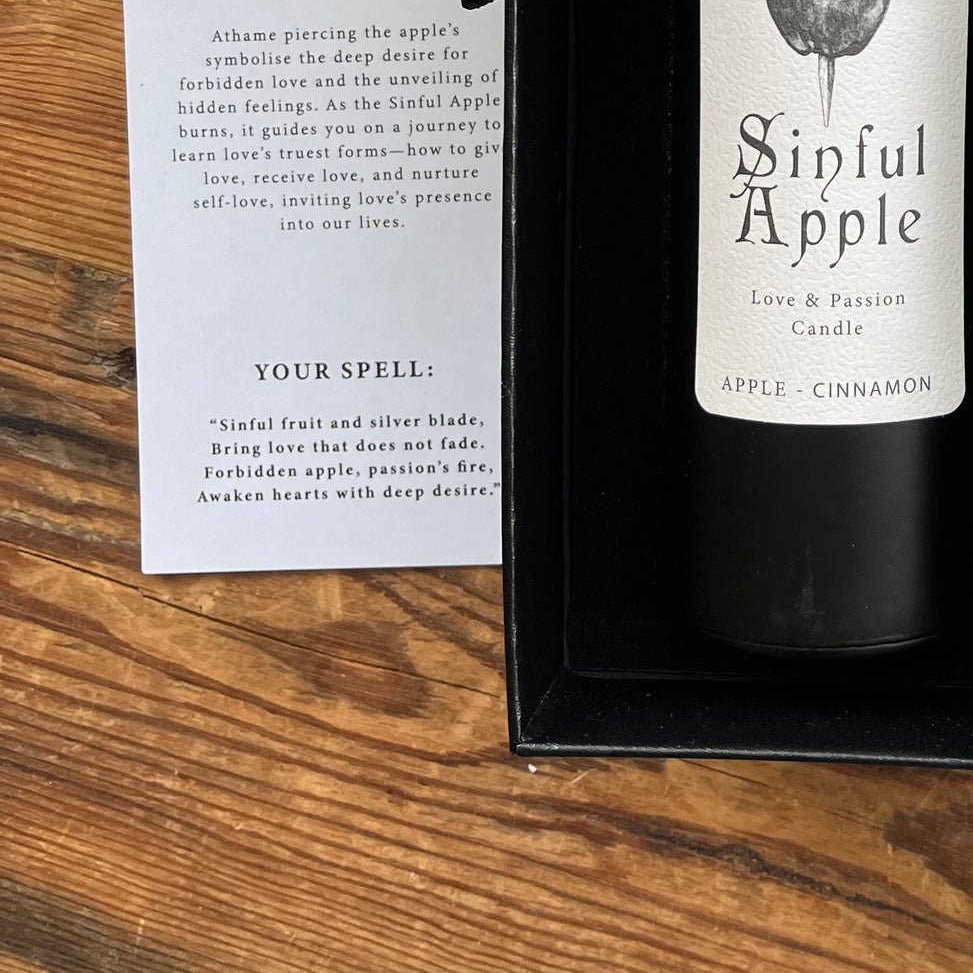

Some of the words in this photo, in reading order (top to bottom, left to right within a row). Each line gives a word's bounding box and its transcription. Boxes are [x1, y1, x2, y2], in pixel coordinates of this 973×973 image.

[211, 28, 277, 43] Athame
[284, 26, 357, 46] piercing
[364, 24, 392, 39] the
[399, 22, 460, 42] apple’s
[205, 51, 292, 71] symbolise
[298, 50, 326, 65] the
[333, 49, 374, 67] deep
[382, 47, 435, 62] desire
[443, 45, 469, 61] for
[179, 75, 264, 91] forbidden
[271, 74, 308, 89] love
[315, 73, 346, 88] and
[353, 72, 381, 87] the
[388, 70, 473, 88] unveiling
[480, 68, 499, 84] of
[177, 99, 237, 115] hidden
[245, 98, 319, 117] feelings.
[325, 98, 347, 112] As
[354, 96, 381, 111] the
[389, 94, 442, 110] Sinful
[448, 92, 501, 112] Apple
[178, 124, 234, 139] burns,
[241, 123, 254, 137] it
[262, 121, 318, 141] guides
[324, 124, 356, 140] you
[363, 124, 385, 134] on
[392, 123, 401, 133] a
[408, 119, 477, 137] journey
[484, 118, 501, 131] to
[172, 148, 216, 162] learn
[223, 146, 272, 161] love’s
[279, 147, 330, 160] truest
[449, 143, 466, 156] to
[474, 141, 500, 159] giv
[729, 112, 925, 204] Sinful
[203, 171, 245, 186] love,
[253, 170, 315, 184] receive
[322, 168, 365, 184] love,
[372, 166, 404, 182] and
[412, 167, 479, 180] nurture
[193, 194, 274, 209] self-love,
[282, 193, 352, 210] inviting
[358, 190, 407, 206] love’s
[415, 191, 492, 208] presence
[280, 218, 315, 231] into
[322, 219, 352, 230] our
[358, 214, 405, 229] lives.
[733, 180, 922, 269] Apple
[751, 289, 796, 307] Love
[805, 292, 820, 308] &
[830, 291, 905, 308] Passion
[791, 319, 863, 336] Candle
[254, 362, 331, 381] YOUR
[341, 360, 434, 380] SPELL:
[721, 375, 786, 397] APPLE
[812, 375, 931, 399] CINNAMON
[209, 417, 273, 432] “Sinful
[281, 416, 323, 431] fruit
[330, 415, 362, 430] and
[369, 414, 421, 429] silver
[428, 412, 484, 428] blade,
[211, 442, 262, 459] Bring
[268, 440, 305, 454] love
[312, 439, 348, 453] that
[355, 438, 396, 452] does
[403, 438, 433, 451] not
[440, 436, 485, 451] fade.
[204, 464, 297, 479] Forbidden
[305, 462, 361, 481] apple,
[368, 459, 450, 479] passion’s
[457, 459, 494, 475] fire,
[196, 488, 264, 503] Awaken
[272, 487, 329, 501] hearts
[335, 485, 375, 500] with
[382, 484, 425, 502] deep
[432, 482, 501, 497] desire.”
